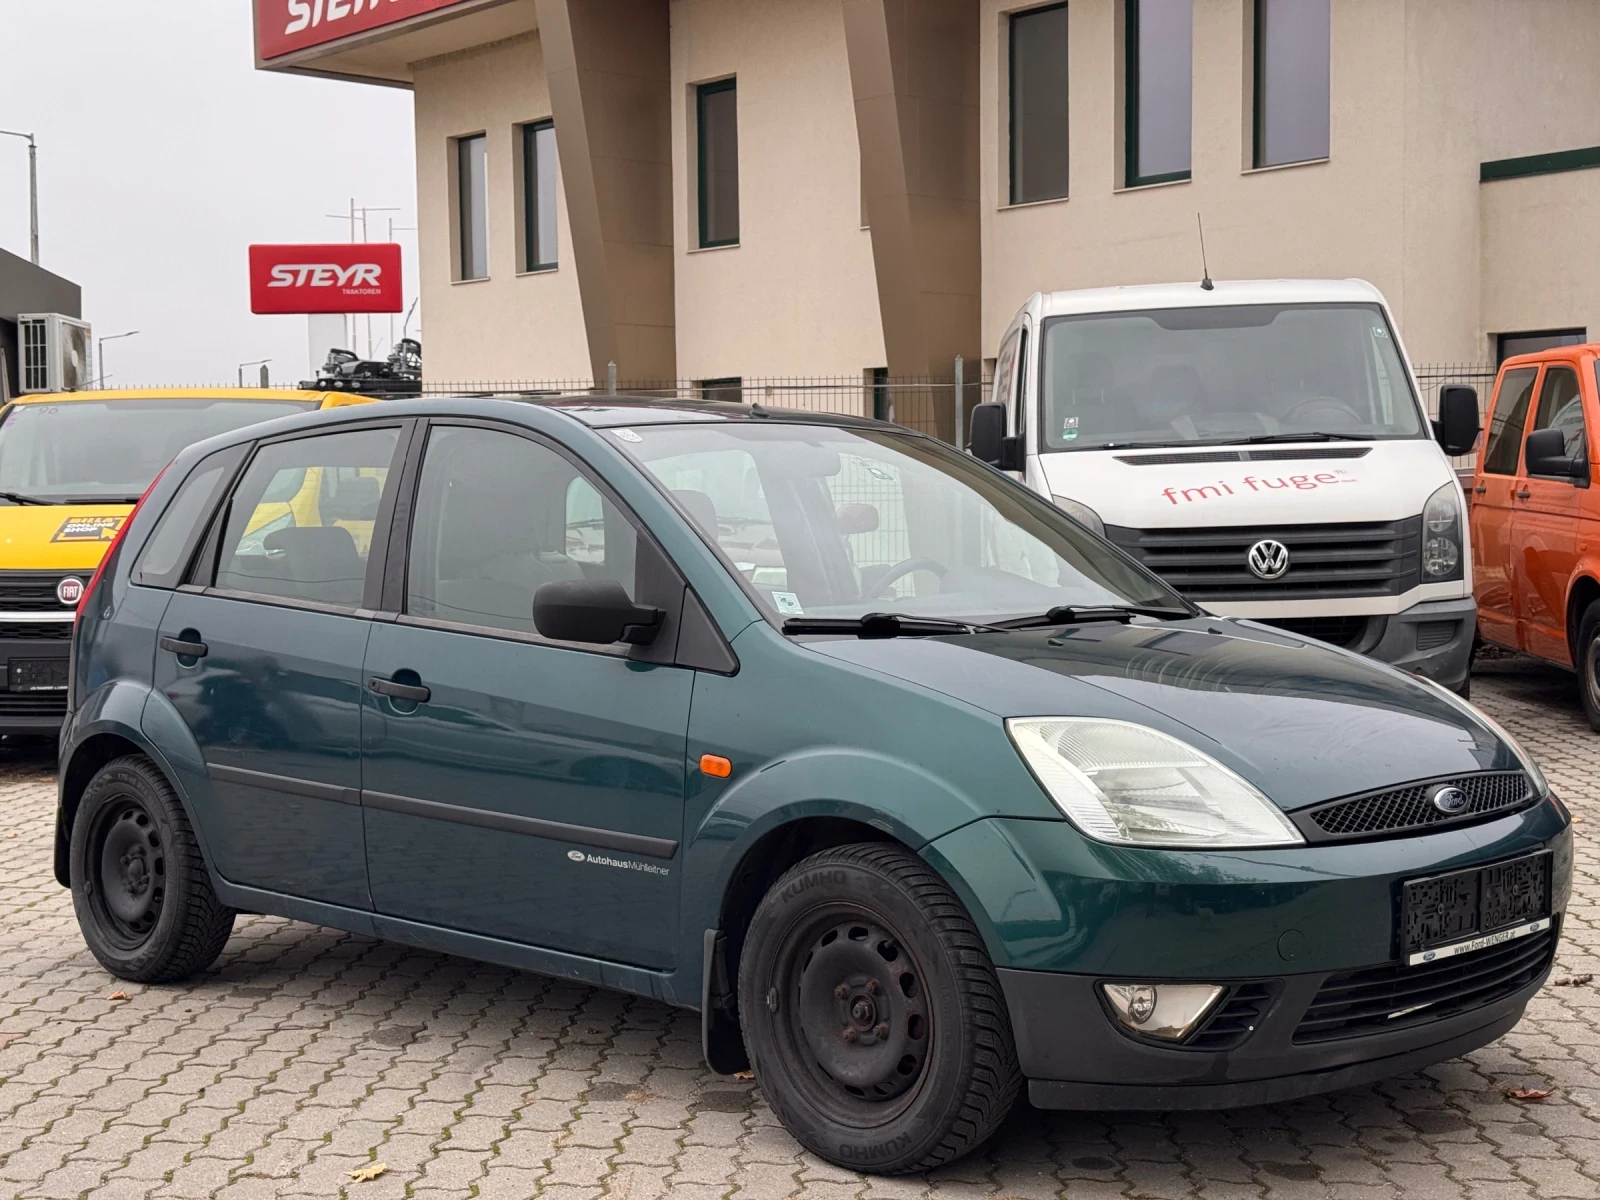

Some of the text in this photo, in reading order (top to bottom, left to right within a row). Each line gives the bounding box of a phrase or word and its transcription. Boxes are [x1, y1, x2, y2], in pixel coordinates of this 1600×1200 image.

[284, 0, 397, 35] STE
[267, 263, 382, 287] STEYR
[1162, 472, 1340, 505] fmi fuge
[63, 585, 78, 598] FIAT
[781, 870, 847, 904] KUMHO
[839, 1131, 912, 1160] KUMHO
